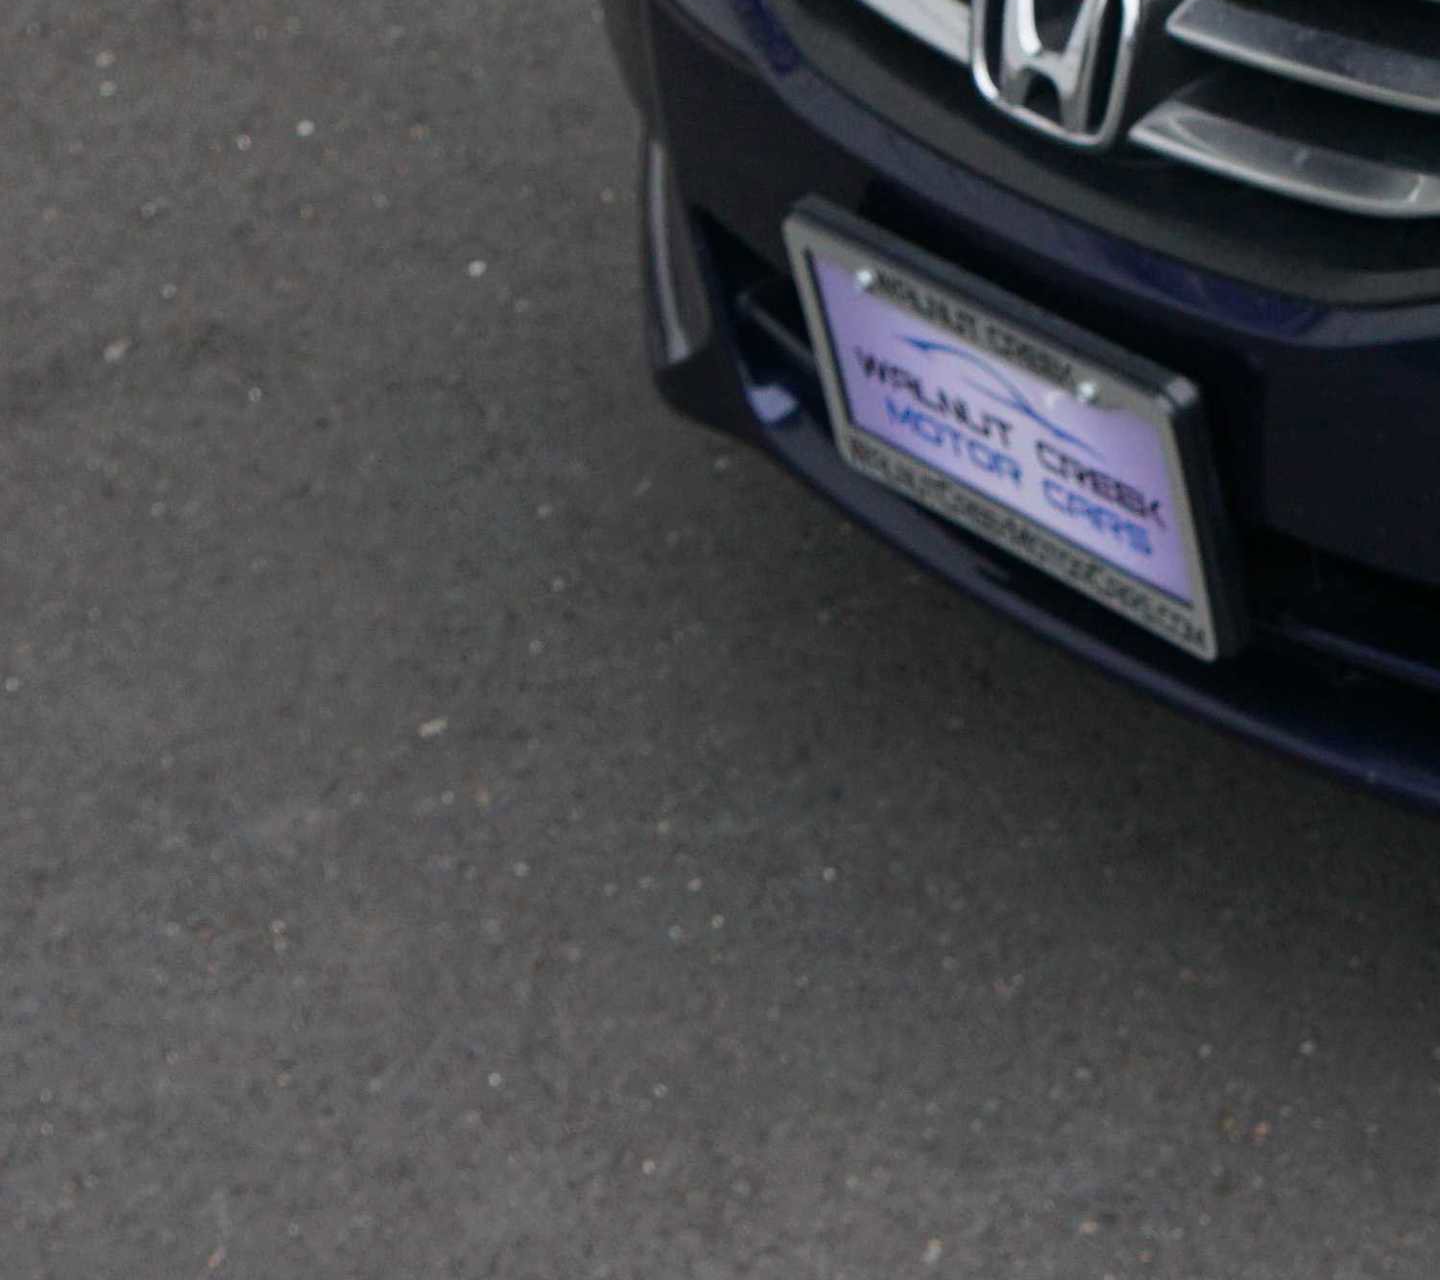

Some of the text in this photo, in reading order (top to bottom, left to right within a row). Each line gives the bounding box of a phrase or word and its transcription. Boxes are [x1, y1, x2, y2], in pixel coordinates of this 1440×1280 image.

[854, 344, 1167, 530] WALNUT CREEK
[883, 397, 1153, 557] MOTOR CARS
